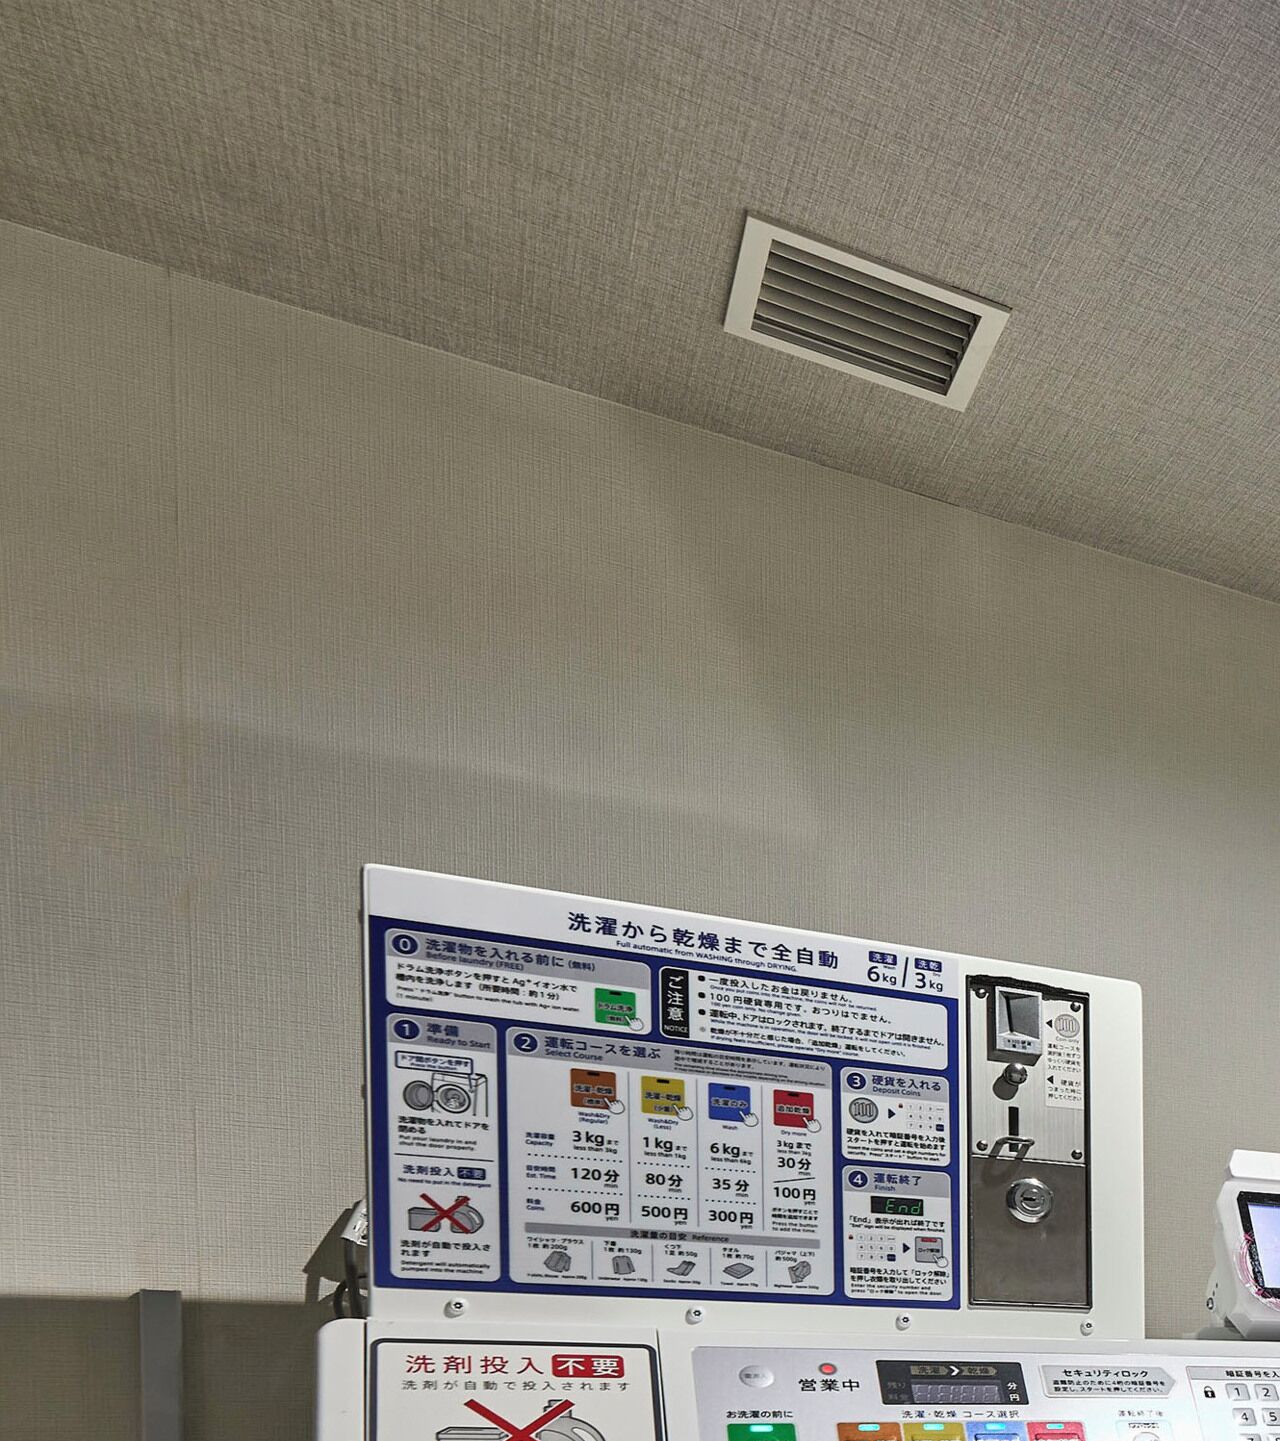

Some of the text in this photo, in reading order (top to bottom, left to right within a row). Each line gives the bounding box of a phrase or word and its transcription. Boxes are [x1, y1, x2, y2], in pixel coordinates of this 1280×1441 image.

[400, 938, 410, 950] 0
[568, 911, 838, 969] 洗濯から乾燥まで全自動
[425, 938, 565, 968] 洗濯物を入れる前に
[616, 940, 631, 949] Full
[632, 942, 673, 955] automatic
[675, 949, 694, 958] from
[696, 952, 733, 964] WASHING
[734, 957, 766, 969] through
[872, 953, 895, 965] 洗濯
[709, 977, 853, 1004] 一度投入したお金は戻りません。
[666, 974, 686, 1022] ご注意
[402, 1023, 410, 1036] 1
[426, 1022, 459, 1037] 準備
[664, 1023, 688, 1034] NOTICE
[469, 1040, 491, 1049] Start
[520, 1036, 531, 1048] 2
[544, 1035, 662, 1060] 運転コースを選ぶ
[544, 1049, 603, 1062] Select Course
[852, 1075, 861, 1087] 3
[872, 1074, 941, 1092] 硬貨を入れる
[872, 1086, 921, 1097] Deposit Coins
[571, 1167, 620, 1183] 120分
[645, 1173, 683, 1187] 80分
[853, 1173, 863, 1185] 4
[873, 1172, 921, 1186] 運転終了
[712, 1178, 749, 1192] 35分
[874, 1184, 896, 1192] Finish
[773, 1186, 816, 1201] 100円
[570, 1201, 620, 1216] 600円
[641, 1205, 688, 1220] 500円
[885, 1198, 921, 1215] End
[708, 1209, 753, 1225] 300円
[405, 1354, 620, 1377] 洗剤投入 不要
[1063, 1369, 1149, 1378] セキュリティロック
[401, 1379, 631, 1392] 洗剤が自動で投入されます
[798, 1378, 861, 1392] 営業中
[1006, 1381, 1018, 1390] 分
[1010, 1393, 1020, 1402] 円
[1234, 1387, 1242, 1398] 1
[1262, 1388, 1271, 1398] 2
[725, 1410, 794, 1419] お洗濯の前に
[963, 1409, 1020, 1419] コース選択
[1241, 1412, 1249, 1422] 4
[1269, 1412, 1278, 1422] 5
